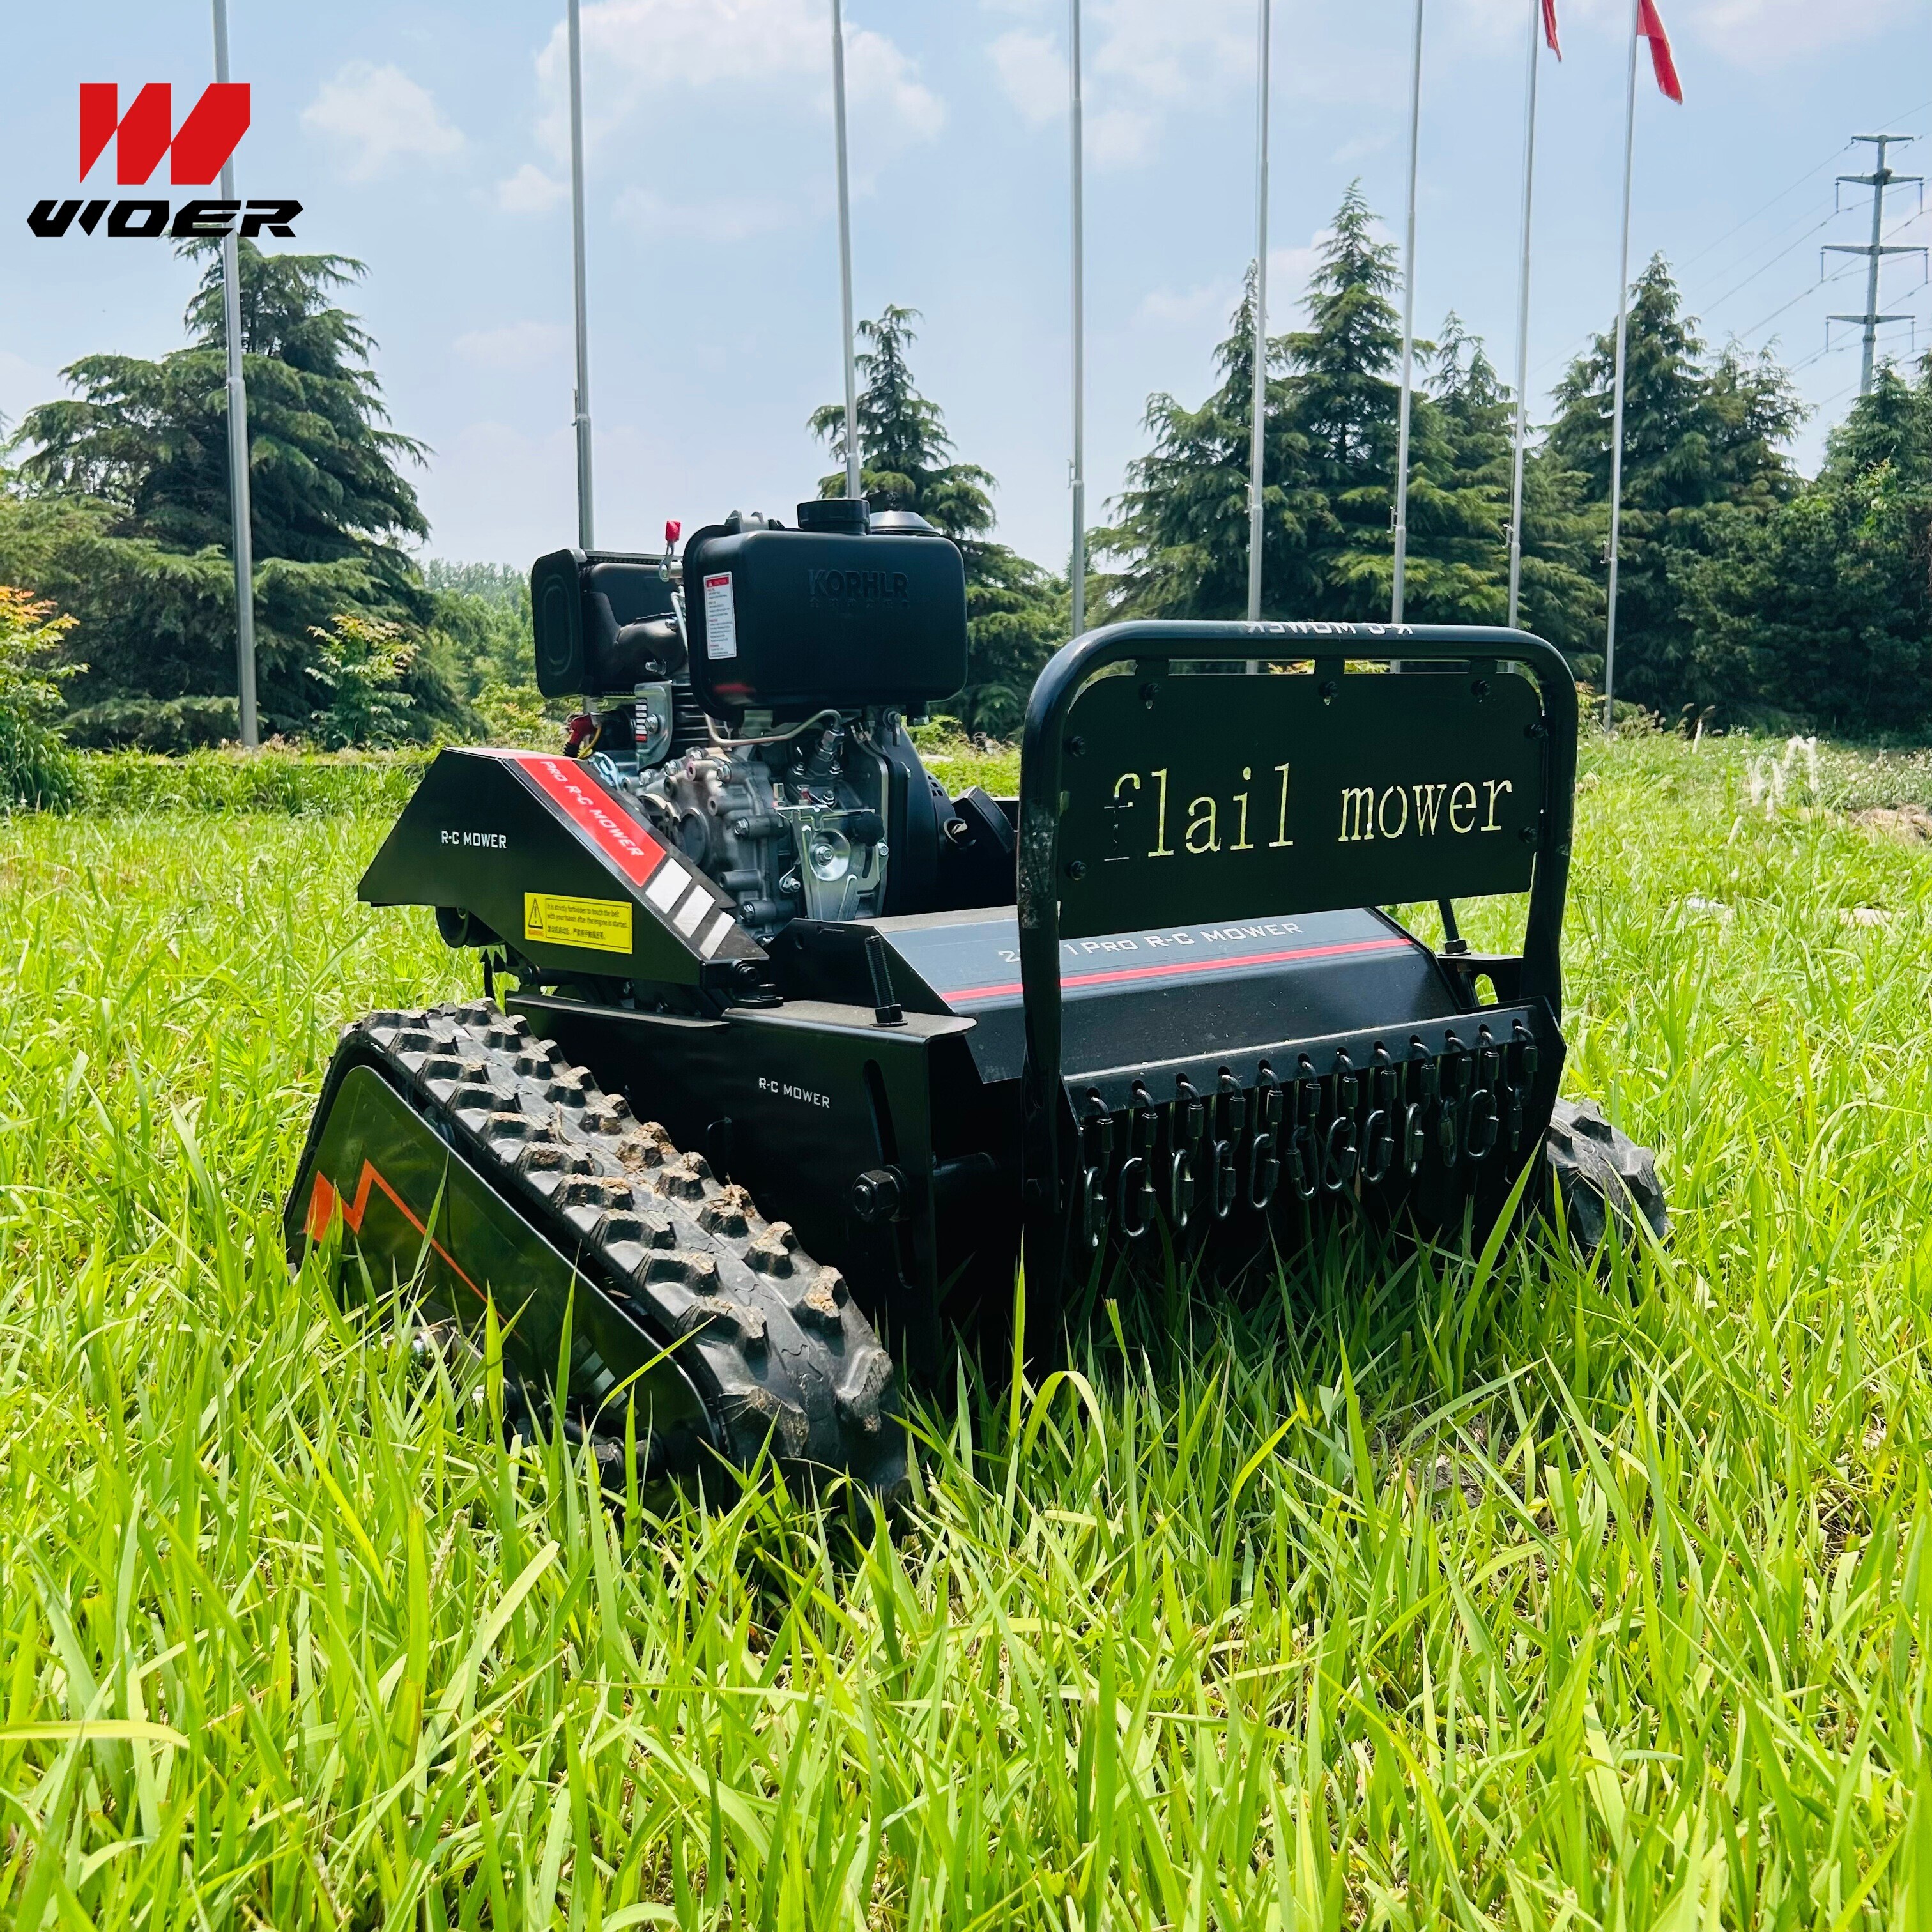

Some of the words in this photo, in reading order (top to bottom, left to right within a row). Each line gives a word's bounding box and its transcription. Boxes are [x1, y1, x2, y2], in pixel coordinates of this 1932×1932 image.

[540, 761, 567, 782] PRO
[588, 809, 645, 856] MOWER
[1103, 762, 1294, 861] flail
[1338, 779, 1512, 842] mower
[463, 832, 507, 849] MOWER
[1080, 940, 1138, 955] PRO
[1200, 922, 1305, 942] MOWER
[783, 1084, 830, 1108] MOWER
